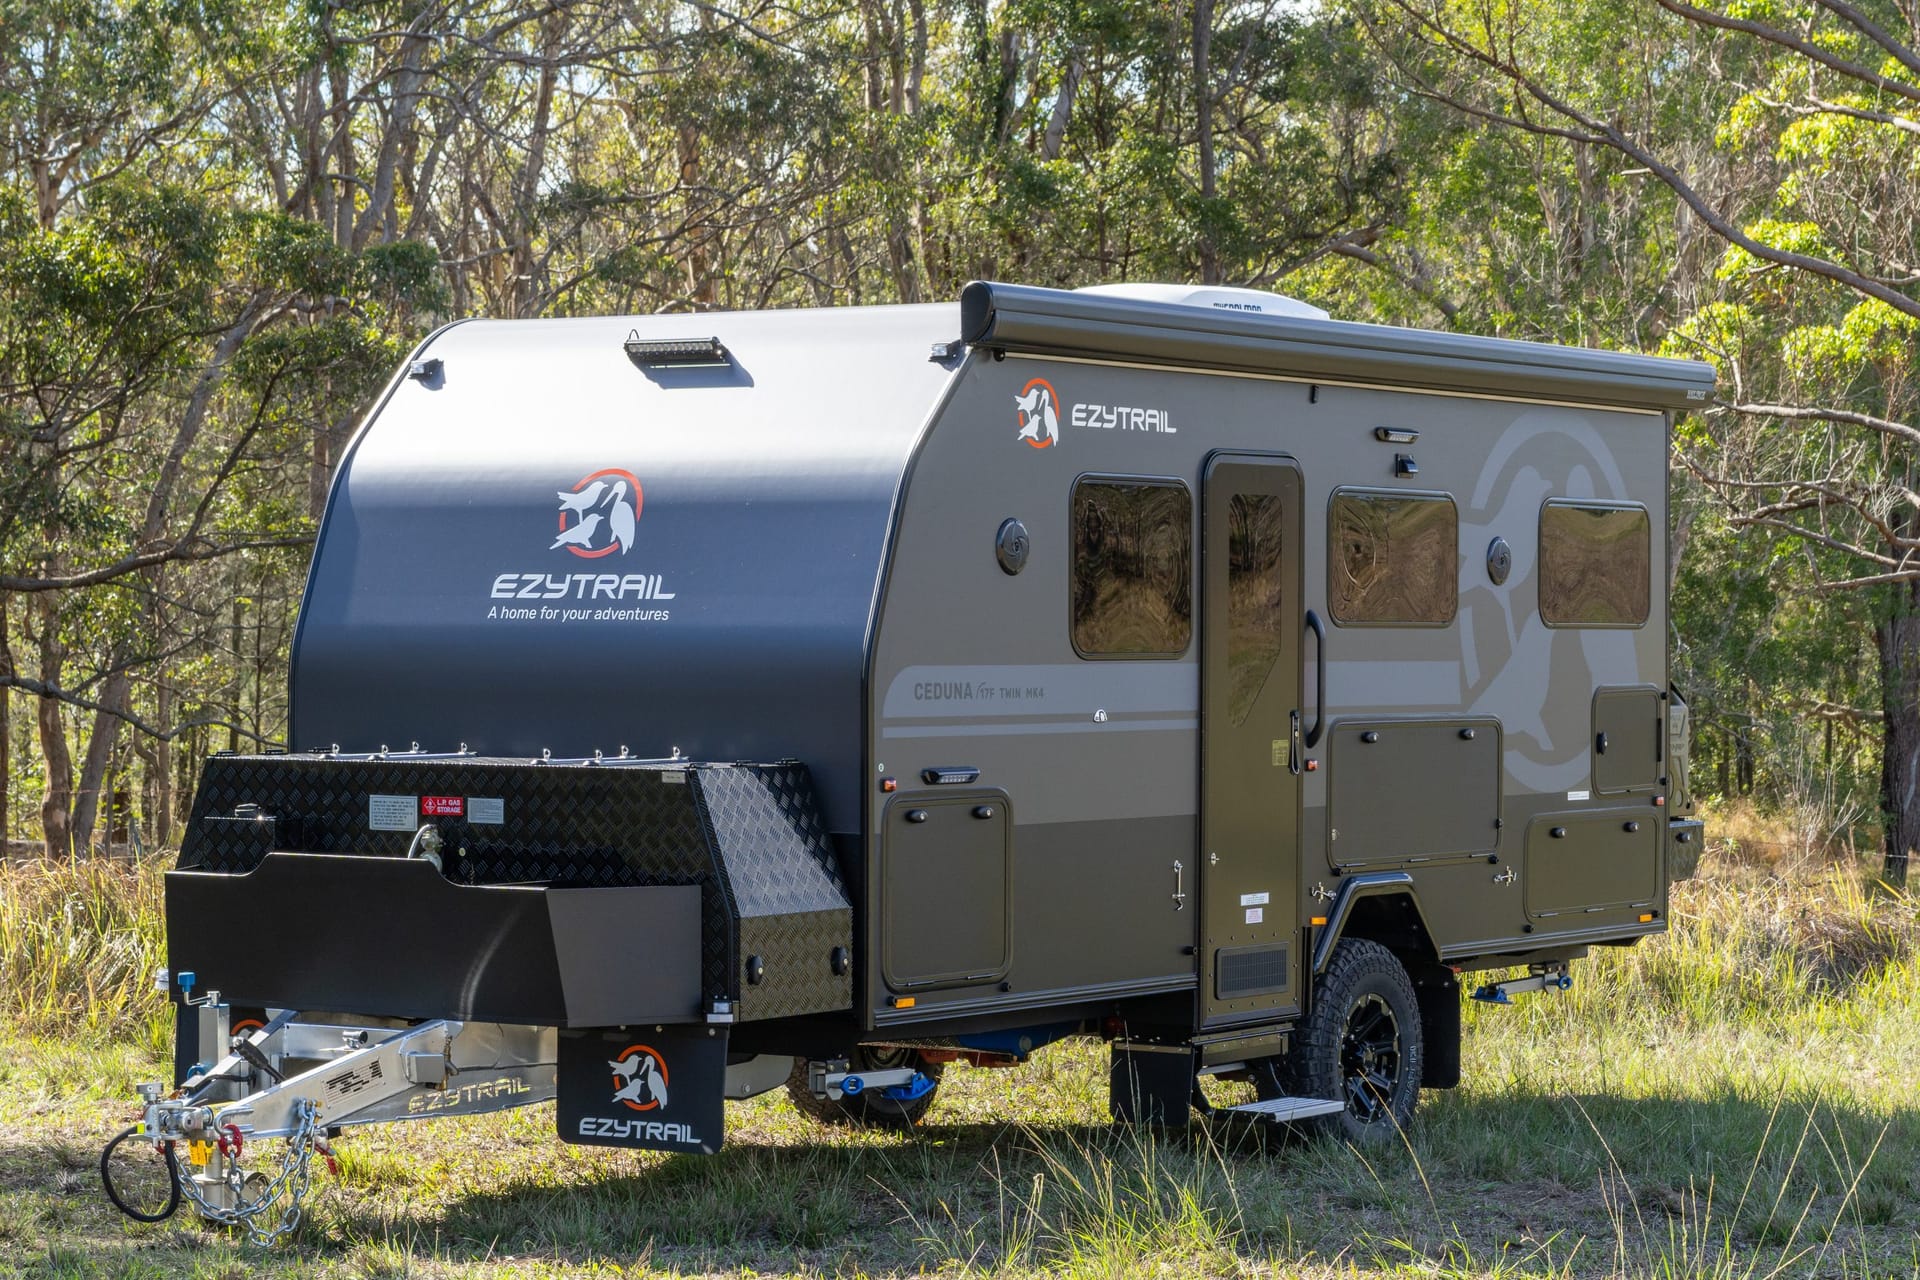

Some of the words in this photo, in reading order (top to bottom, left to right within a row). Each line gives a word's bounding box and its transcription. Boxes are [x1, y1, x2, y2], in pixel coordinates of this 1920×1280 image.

[1072, 403, 1177, 433] EZYTRAIL
[490, 573, 676, 600] EZYTRAIL
[488, 606, 497, 619] A
[500, 606, 537, 620] home
[540, 606, 560, 620] for
[562, 608, 592, 622] your
[594, 607, 670, 621] adventures
[914, 682, 973, 700] CEDUNA
[1000, 687, 1021, 698] TWIN
[1026, 687, 1044, 698] MK4
[408, 1077, 532, 1113] EZYTRAIL
[579, 1117, 702, 1144] EZYTRAIL
